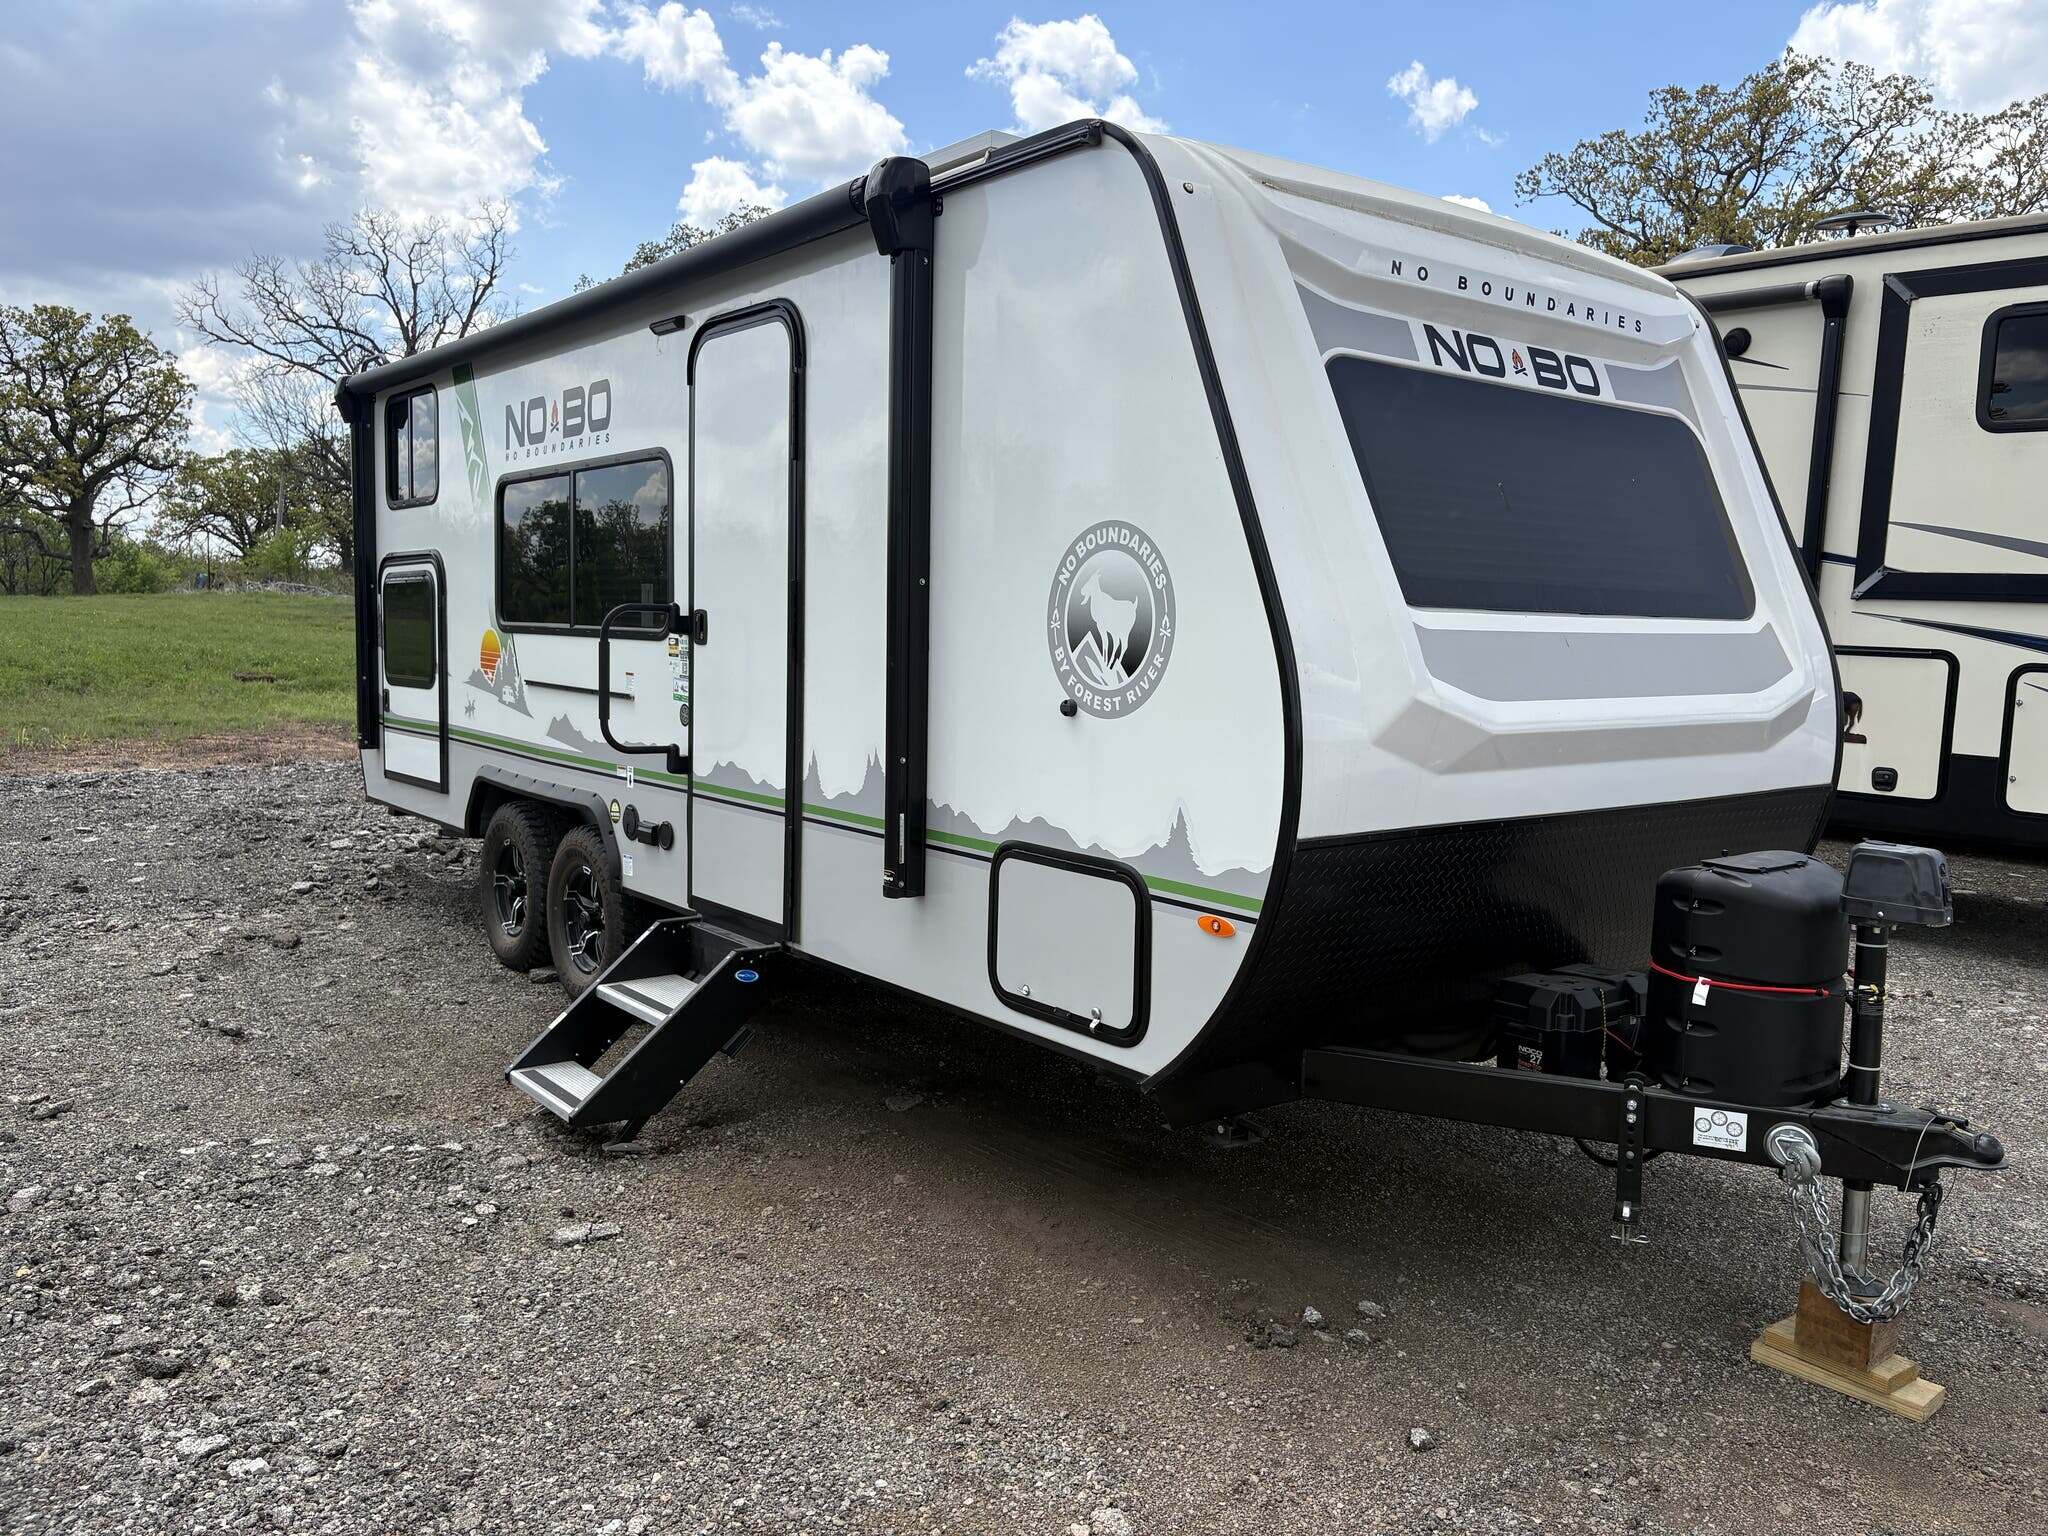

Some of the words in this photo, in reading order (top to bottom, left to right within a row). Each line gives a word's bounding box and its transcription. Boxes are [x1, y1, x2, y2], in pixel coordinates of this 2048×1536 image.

[1391, 259, 1429, 282] NO
[1457, 275, 1643, 333] BOUNDARIES
[505, 451, 518, 462] NO
[526, 433, 611, 458] BOUNDARIES
[1058, 555, 1077, 586] NO
[1075, 526, 1167, 590] BOUNDARIES
[1054, 646, 1071, 674] BY
[1067, 673, 1122, 712] FOREST
[1126, 653, 1165, 705] RIVER
[1530, 1054, 1542, 1065] 27
